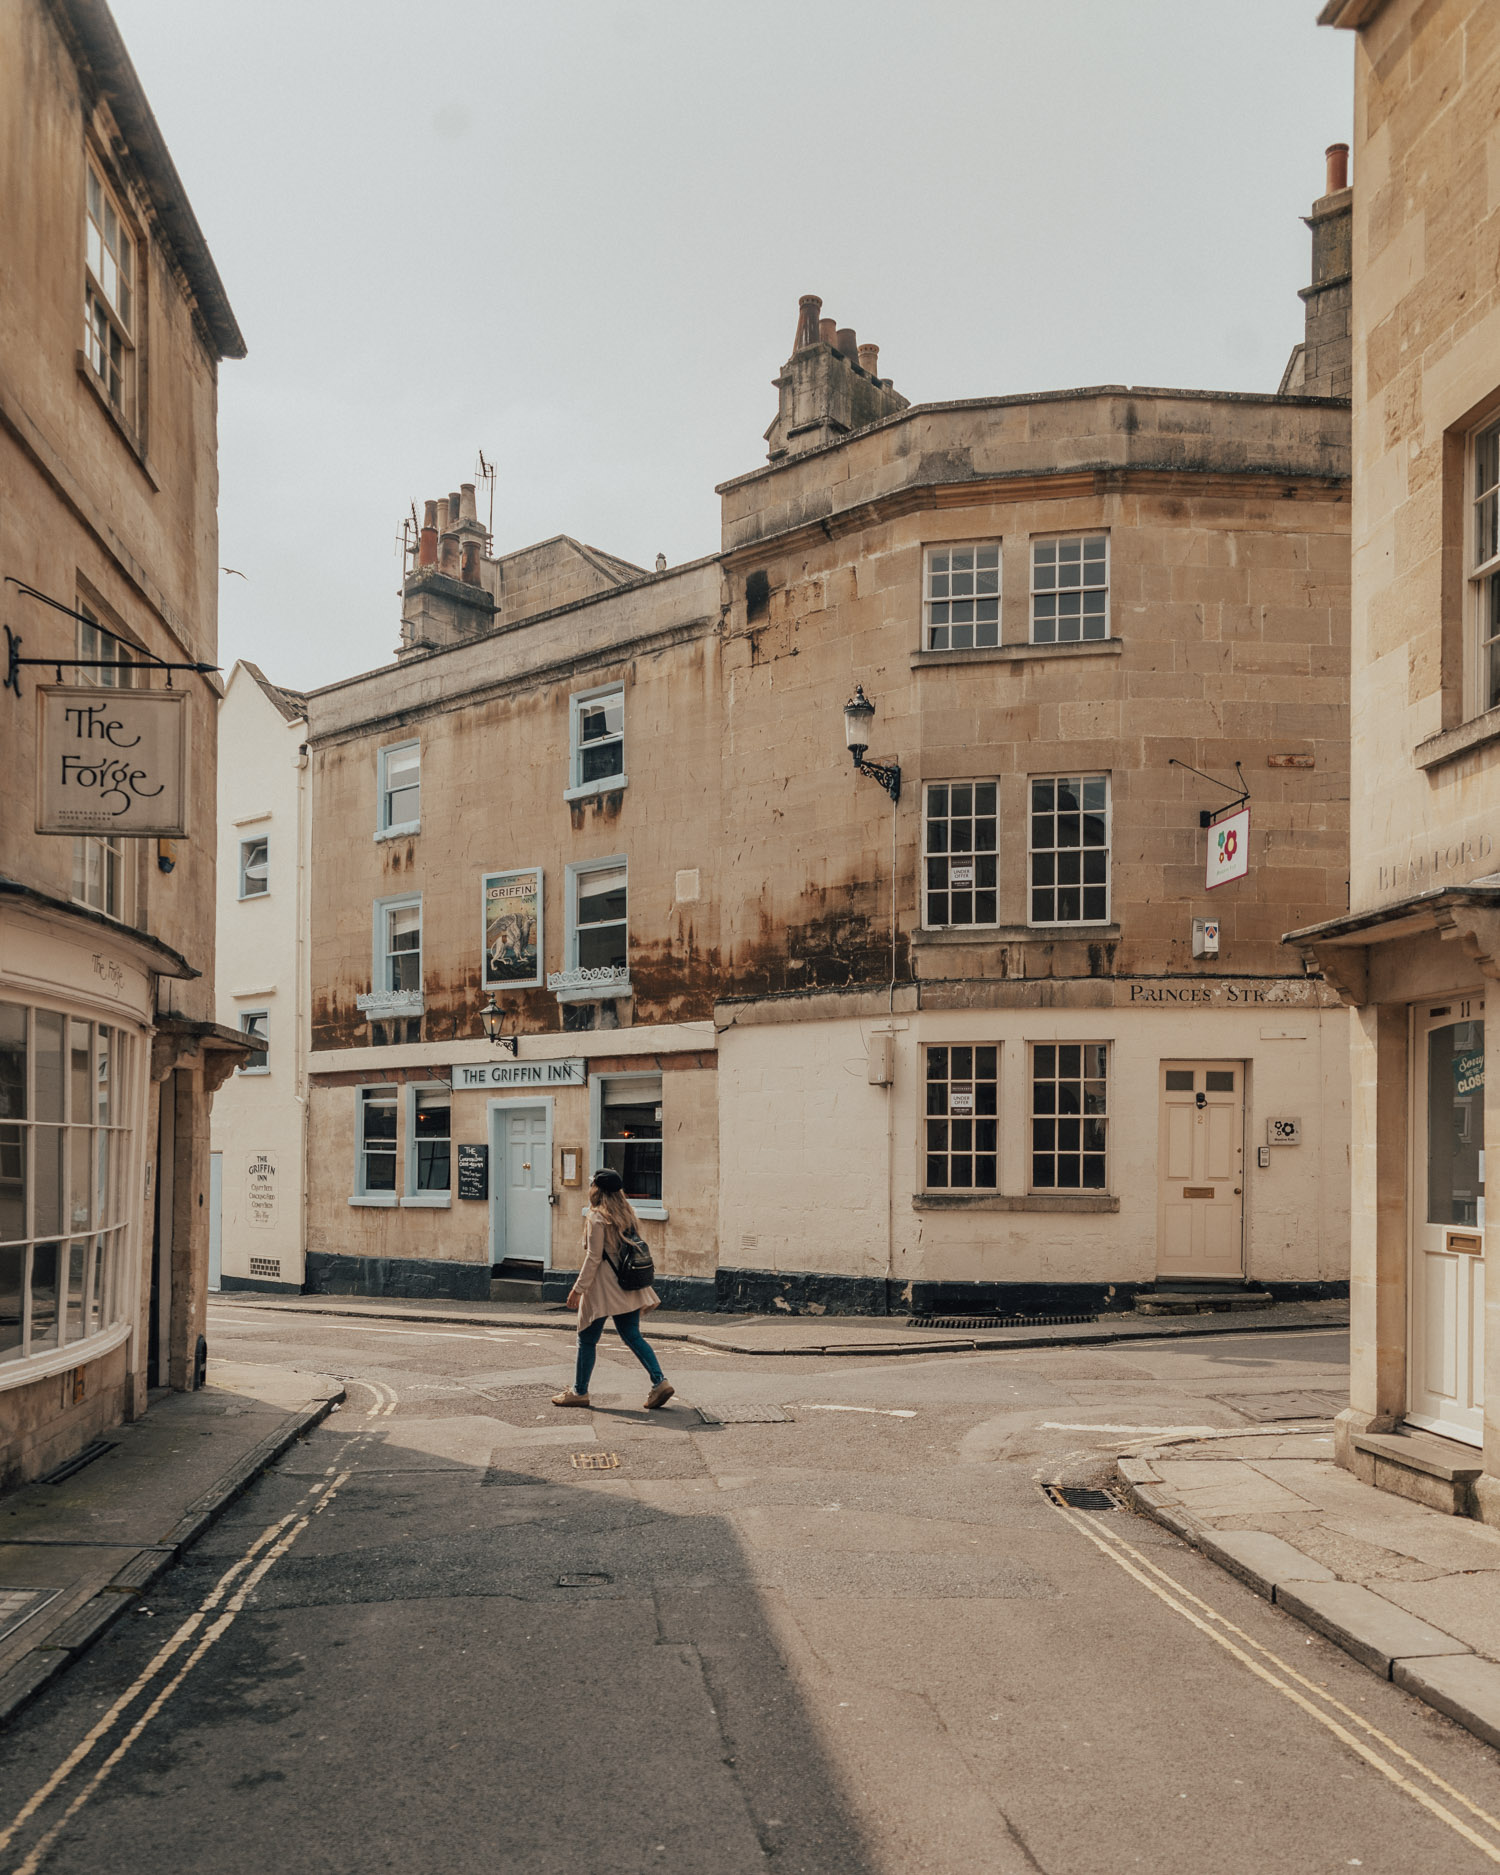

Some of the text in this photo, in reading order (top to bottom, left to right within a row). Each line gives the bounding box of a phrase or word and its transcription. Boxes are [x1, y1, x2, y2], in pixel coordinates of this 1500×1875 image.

[65, 703, 141, 748] The
[61, 755, 165, 816] Forge
[491, 885, 532, 898] GRIFFIN
[1130, 985, 1305, 1002] PRINCES STR
[1461, 1000, 1471, 1018] 11
[463, 1065, 572, 1083] THE GRIFFIN INN
[1197, 1115, 1203, 1124] 2
[464, 1146, 477, 1155] THE
[248, 1164, 275, 1175] GRIFFIN
